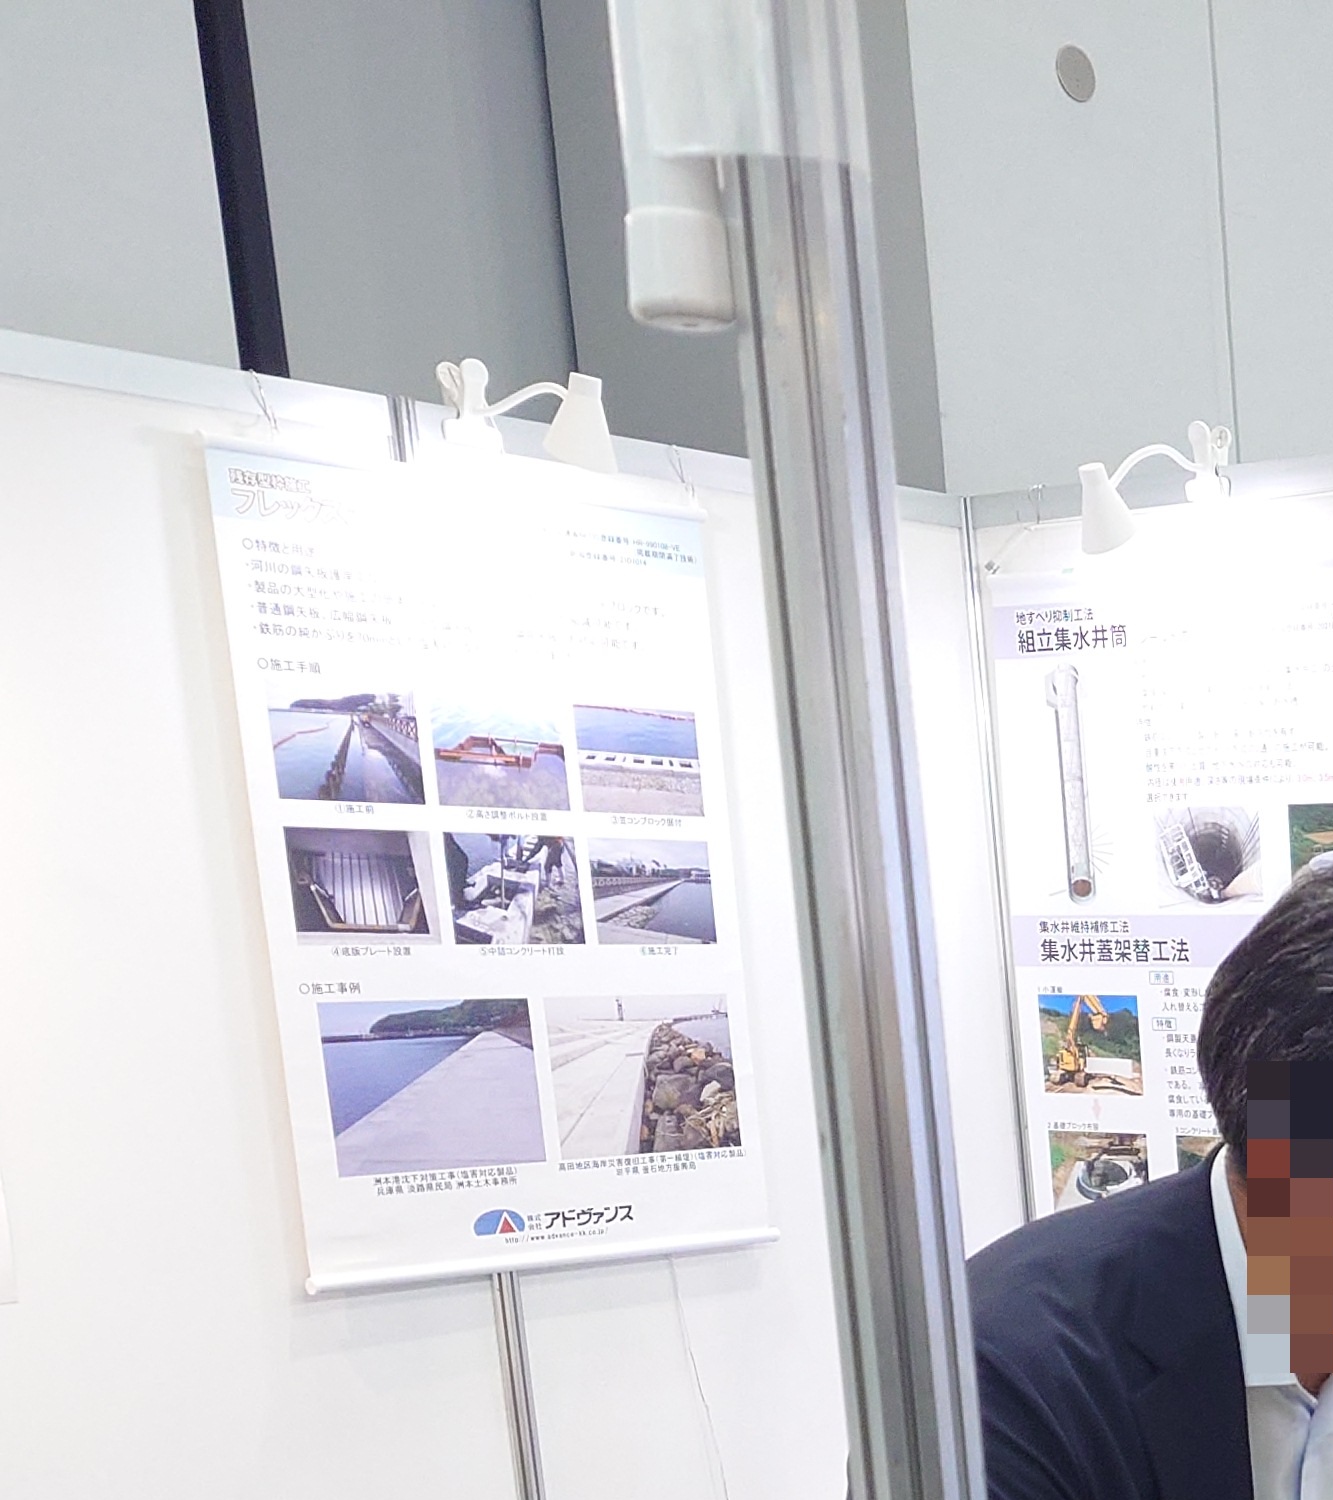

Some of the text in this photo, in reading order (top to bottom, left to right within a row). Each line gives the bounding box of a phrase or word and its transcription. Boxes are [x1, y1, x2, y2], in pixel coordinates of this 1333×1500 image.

[1018, 624, 1127, 653] 組立集水井筒
[1040, 937, 1190, 963] 集水井蓋架替工法
[545, 1204, 634, 1230] アドヴァンス
